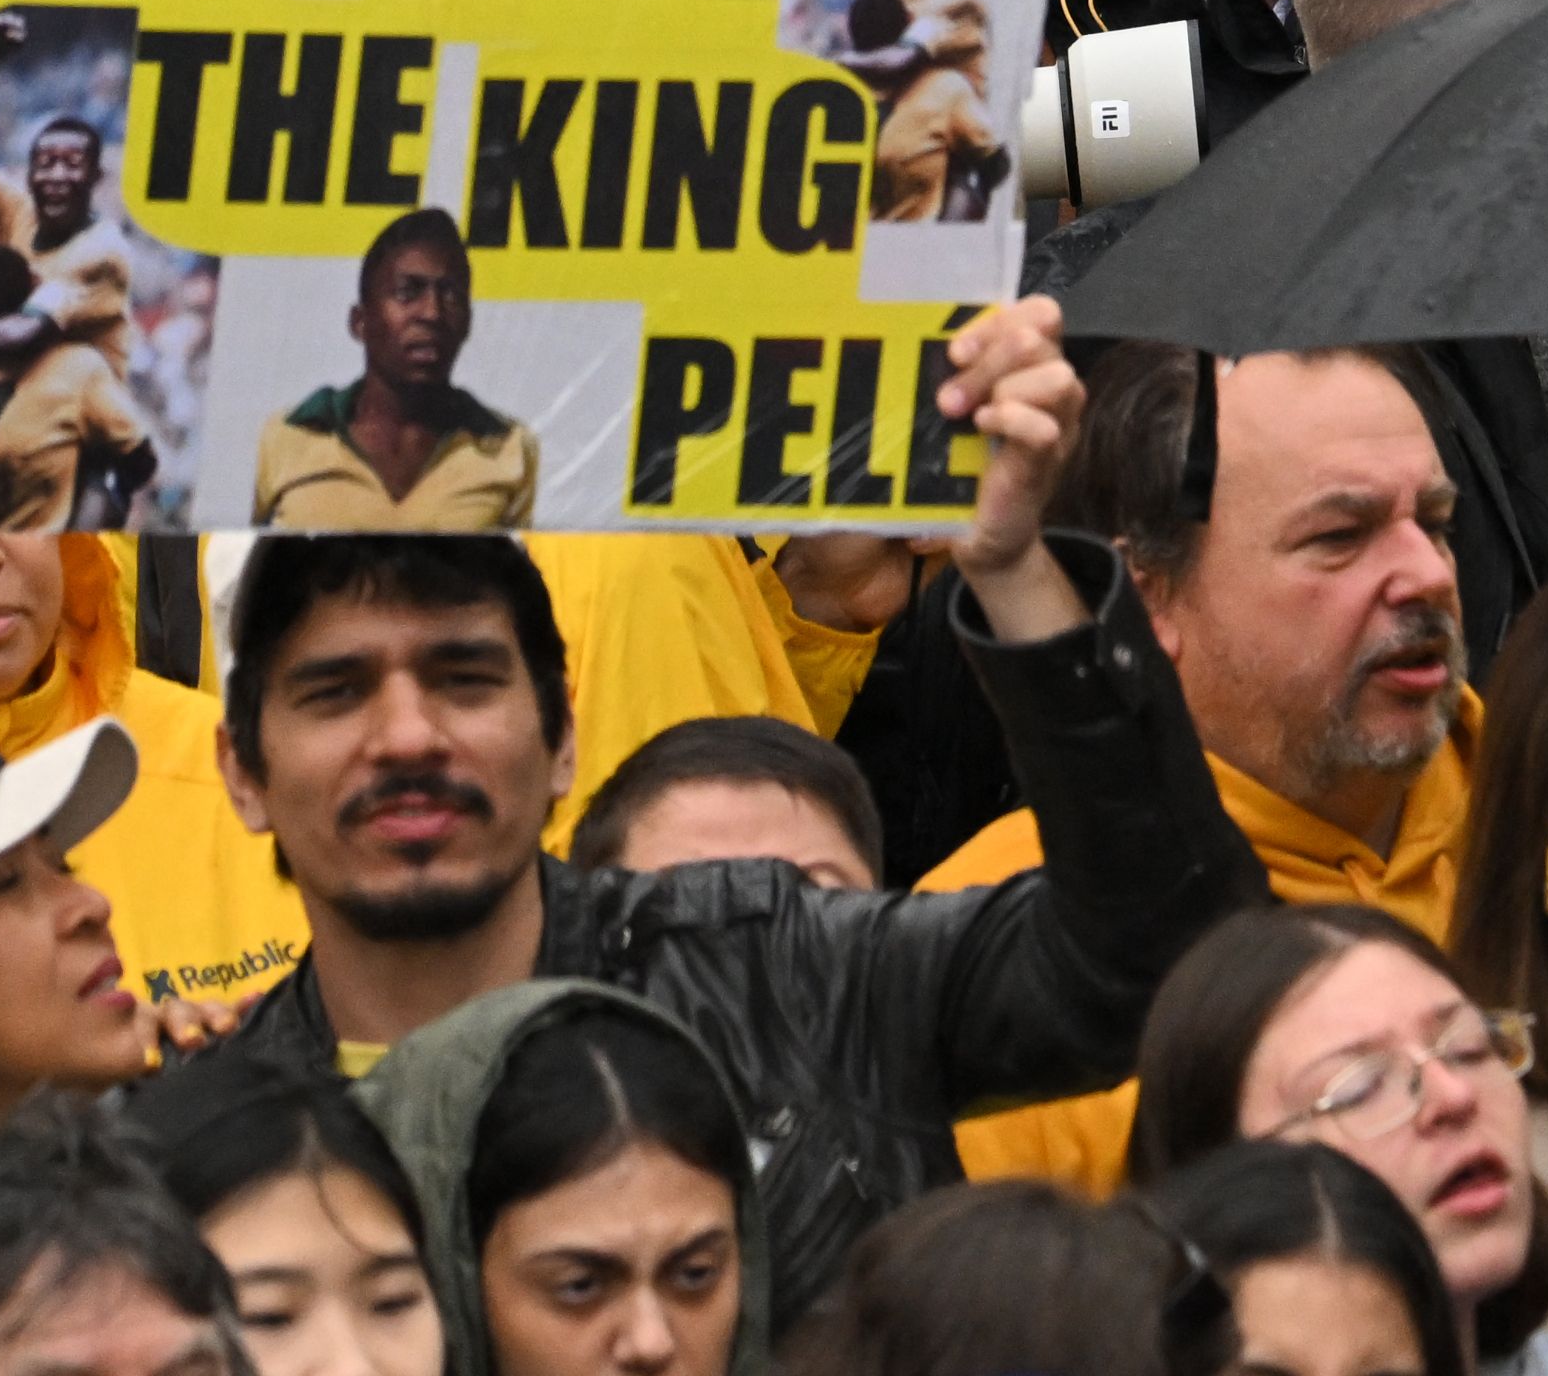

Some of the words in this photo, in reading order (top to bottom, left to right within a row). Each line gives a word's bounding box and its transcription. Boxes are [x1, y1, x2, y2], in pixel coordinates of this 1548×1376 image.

[138, 30, 436, 207] THE
[467, 78, 871, 254] KING
[178, 937, 301, 993] Republic
